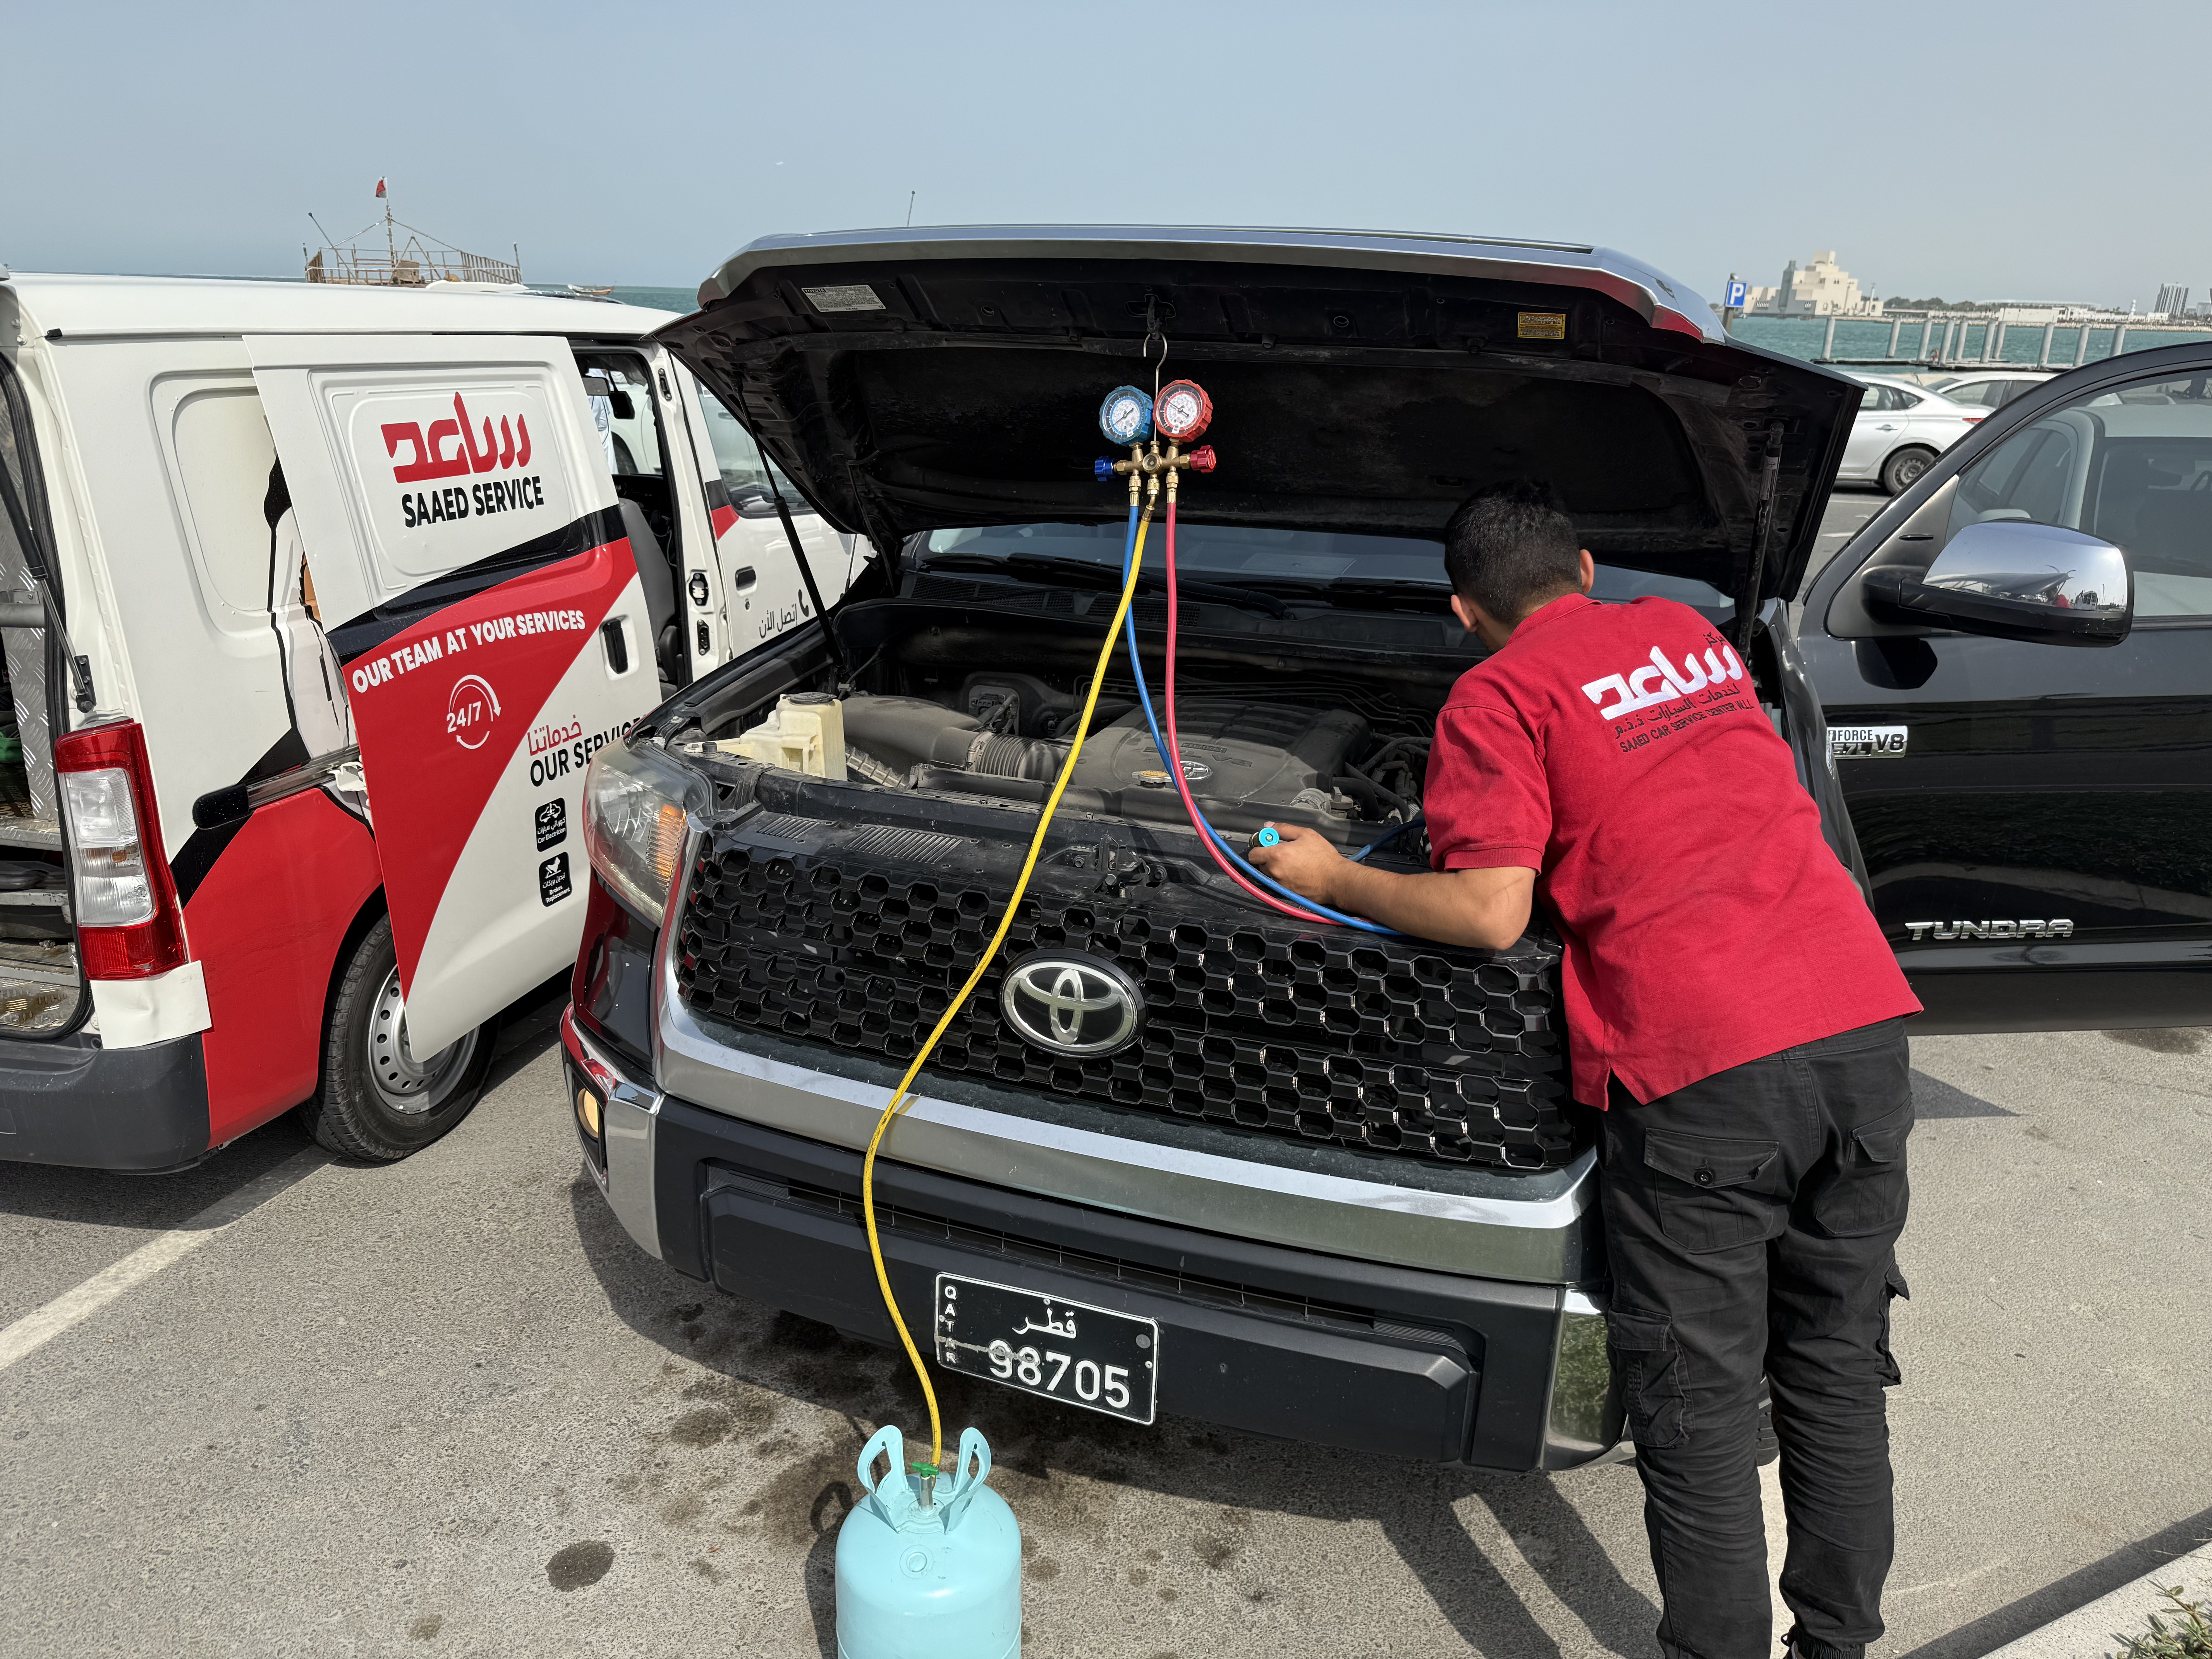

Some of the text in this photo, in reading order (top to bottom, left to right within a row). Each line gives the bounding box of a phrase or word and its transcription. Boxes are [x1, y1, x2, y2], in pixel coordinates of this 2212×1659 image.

[1729, 283, 1743, 305] P
[381, 392, 531, 483] ساعد
[402, 476, 544, 528] SAAED SERVICE
[352, 610, 586, 693] OUR TEAM AT YOUR SERVICES
[1581, 646, 1743, 720] ساعد
[1698, 683, 1741, 704] لخدمات
[447, 701, 481, 733] 24/7
[1647, 697, 1697, 722] السيارات
[527, 714, 582, 756] خدماتنا
[1620, 733, 1650, 752] SAAED
[1650, 725, 1672, 740] CAR
[1670, 711, 1708, 731] SERVICE
[1704, 702, 1738, 716] CENTER
[1874, 733, 1905, 753] V8
[530, 748, 570, 787] OUR
[545, 827, 566, 840] Electrician
[546, 887, 570, 903] Replacement
[549, 885, 563, 895] Brakes
[1905, 918, 2074, 941] TUNDRA
[1012, 1307, 1077, 1339] قطر
[988, 1340, 1130, 1408] 98705
